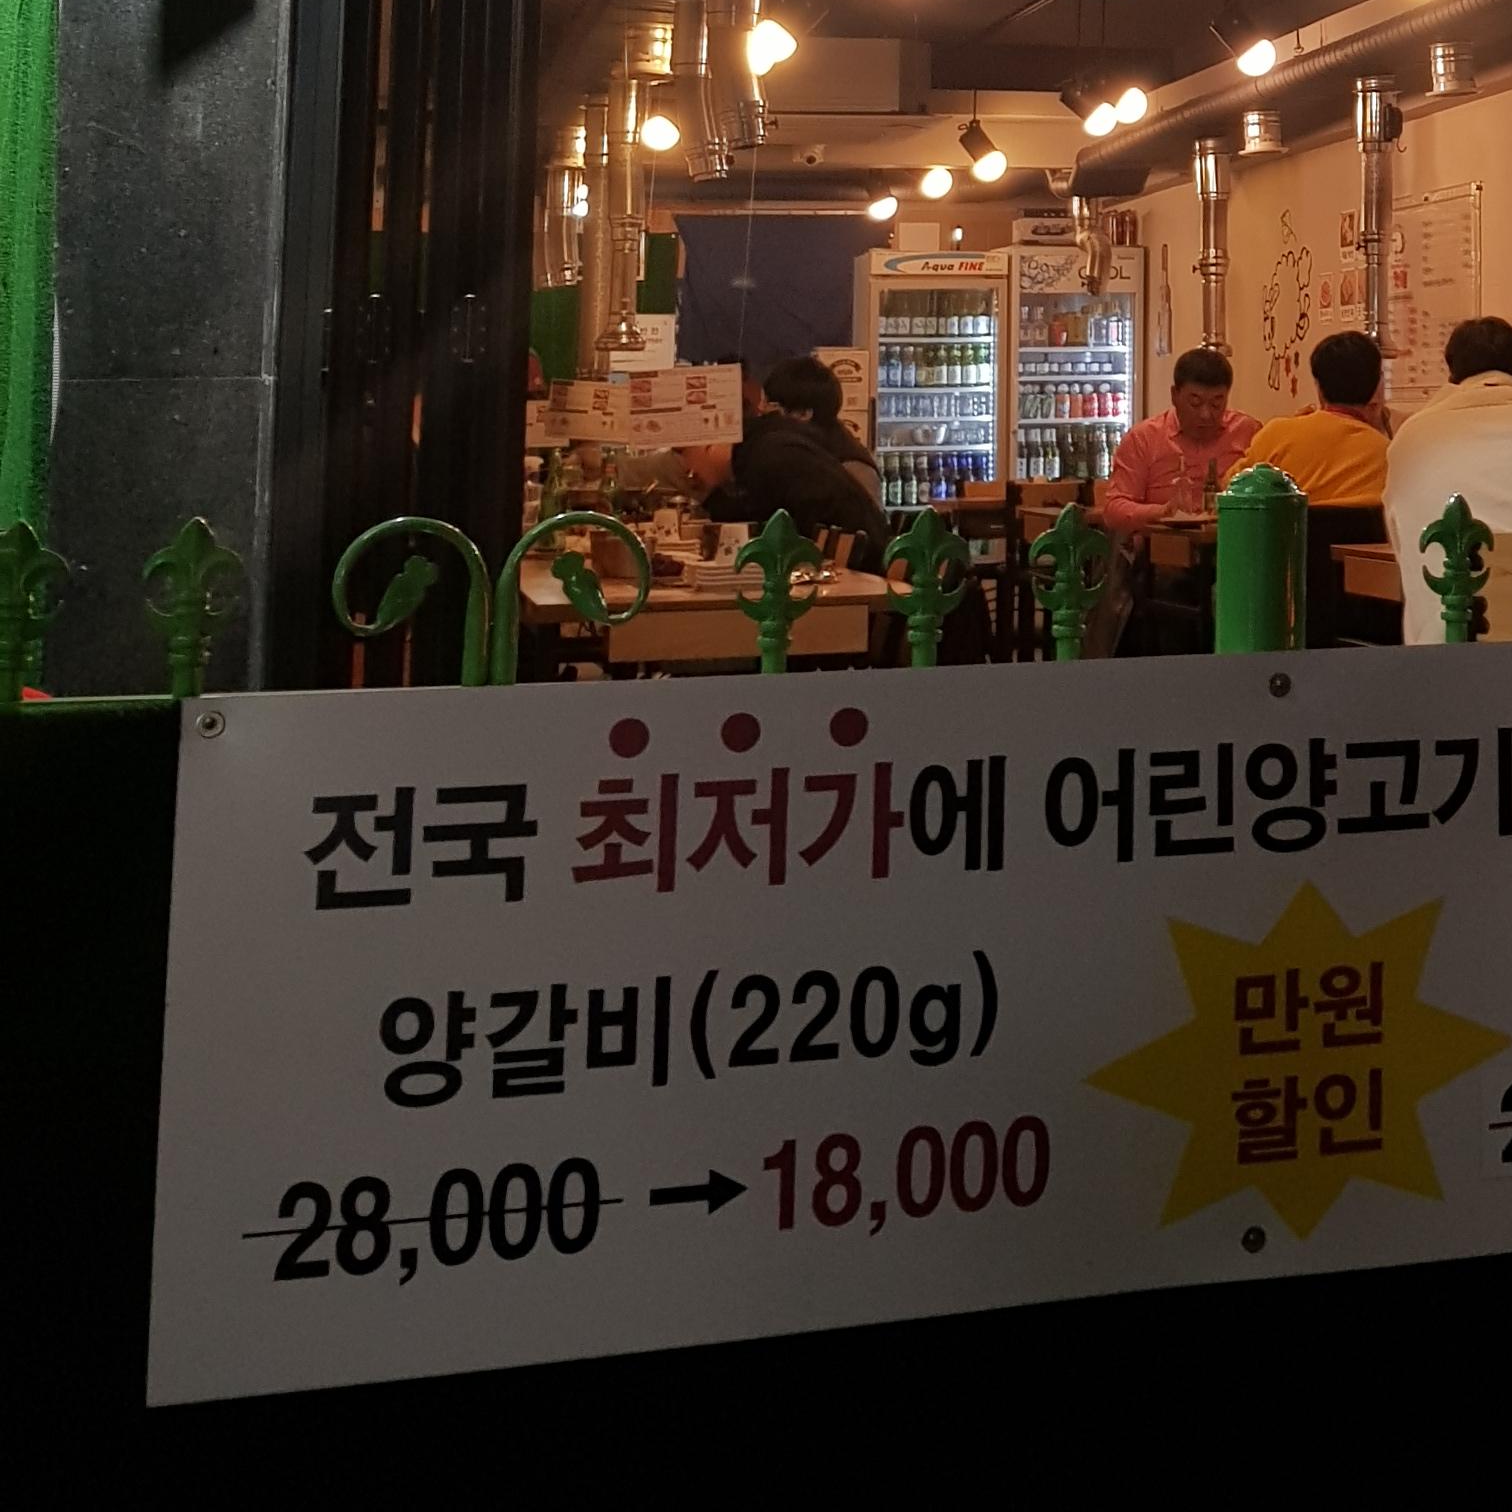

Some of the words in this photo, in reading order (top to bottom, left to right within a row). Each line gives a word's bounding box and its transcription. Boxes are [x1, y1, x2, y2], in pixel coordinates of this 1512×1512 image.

[921, 261, 955, 272] Aqua
[958, 262, 984, 271] FINE
[304, 783, 539, 911] 전국
[571, 755, 1007, 893] 최저가에
[379, 950, 1000, 1109] 양갈비(220g)
[1234, 961, 1384, 1056] 만원
[762, 1115, 1051, 1236] 18,000
[1231, 1067, 1383, 1166] 할인
[272, 1157, 601, 1286] 28,000
